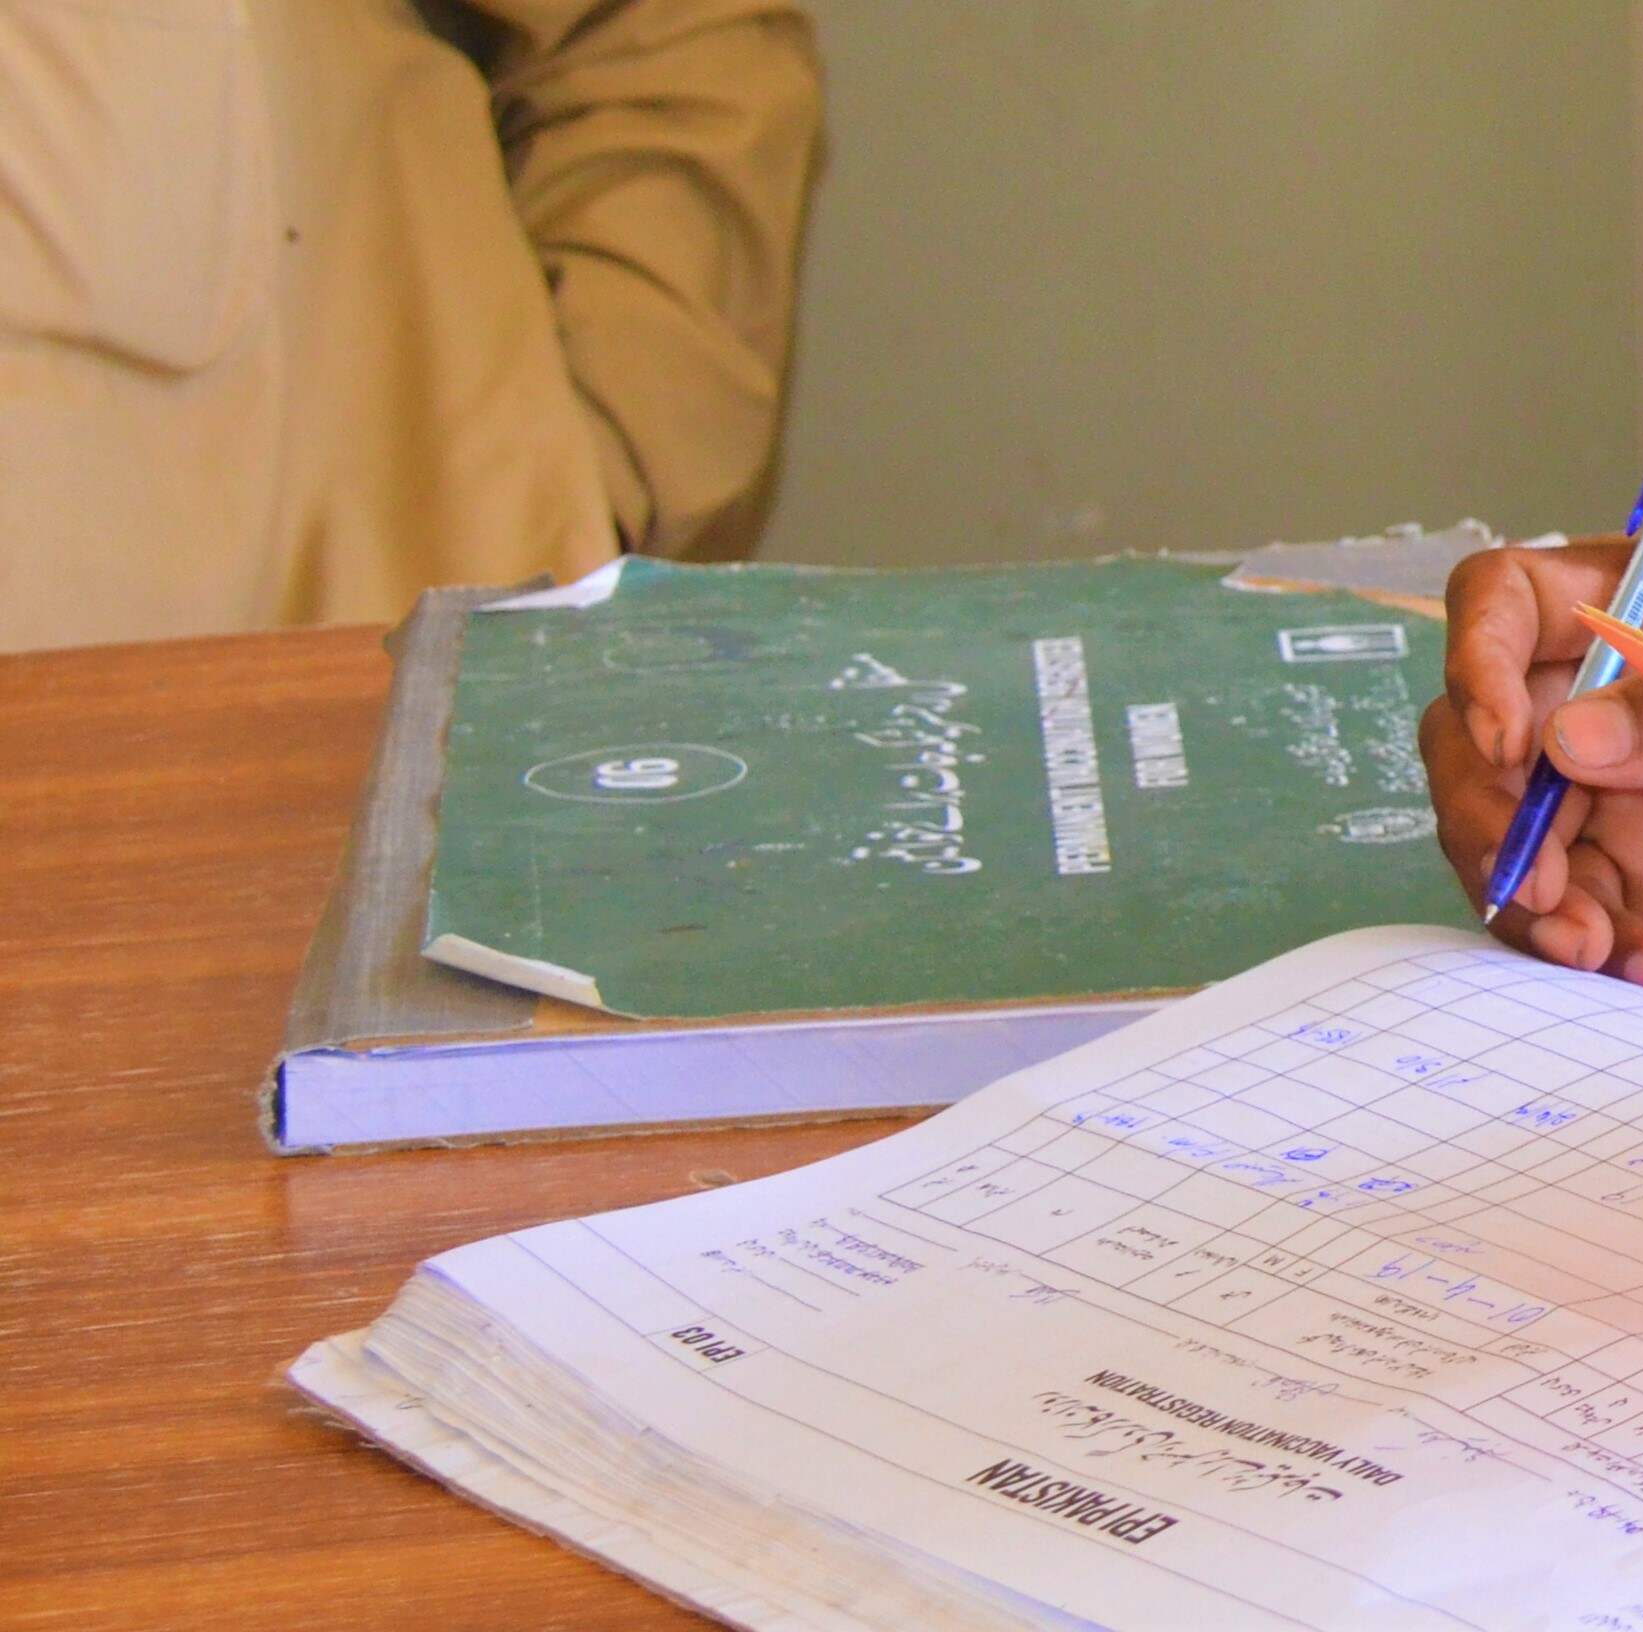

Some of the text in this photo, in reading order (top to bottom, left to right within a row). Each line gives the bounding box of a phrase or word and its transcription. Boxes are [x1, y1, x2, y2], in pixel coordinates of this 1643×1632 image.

[671, 1326, 745, 1364] EPI 03
[1084, 1368, 1229, 1429] REGISTRATION
[1214, 1418, 1345, 1464] VACCINATION
[1335, 1455, 1403, 1486] DAILY
[965, 1457, 1179, 1546] EPI PAKISTAN
